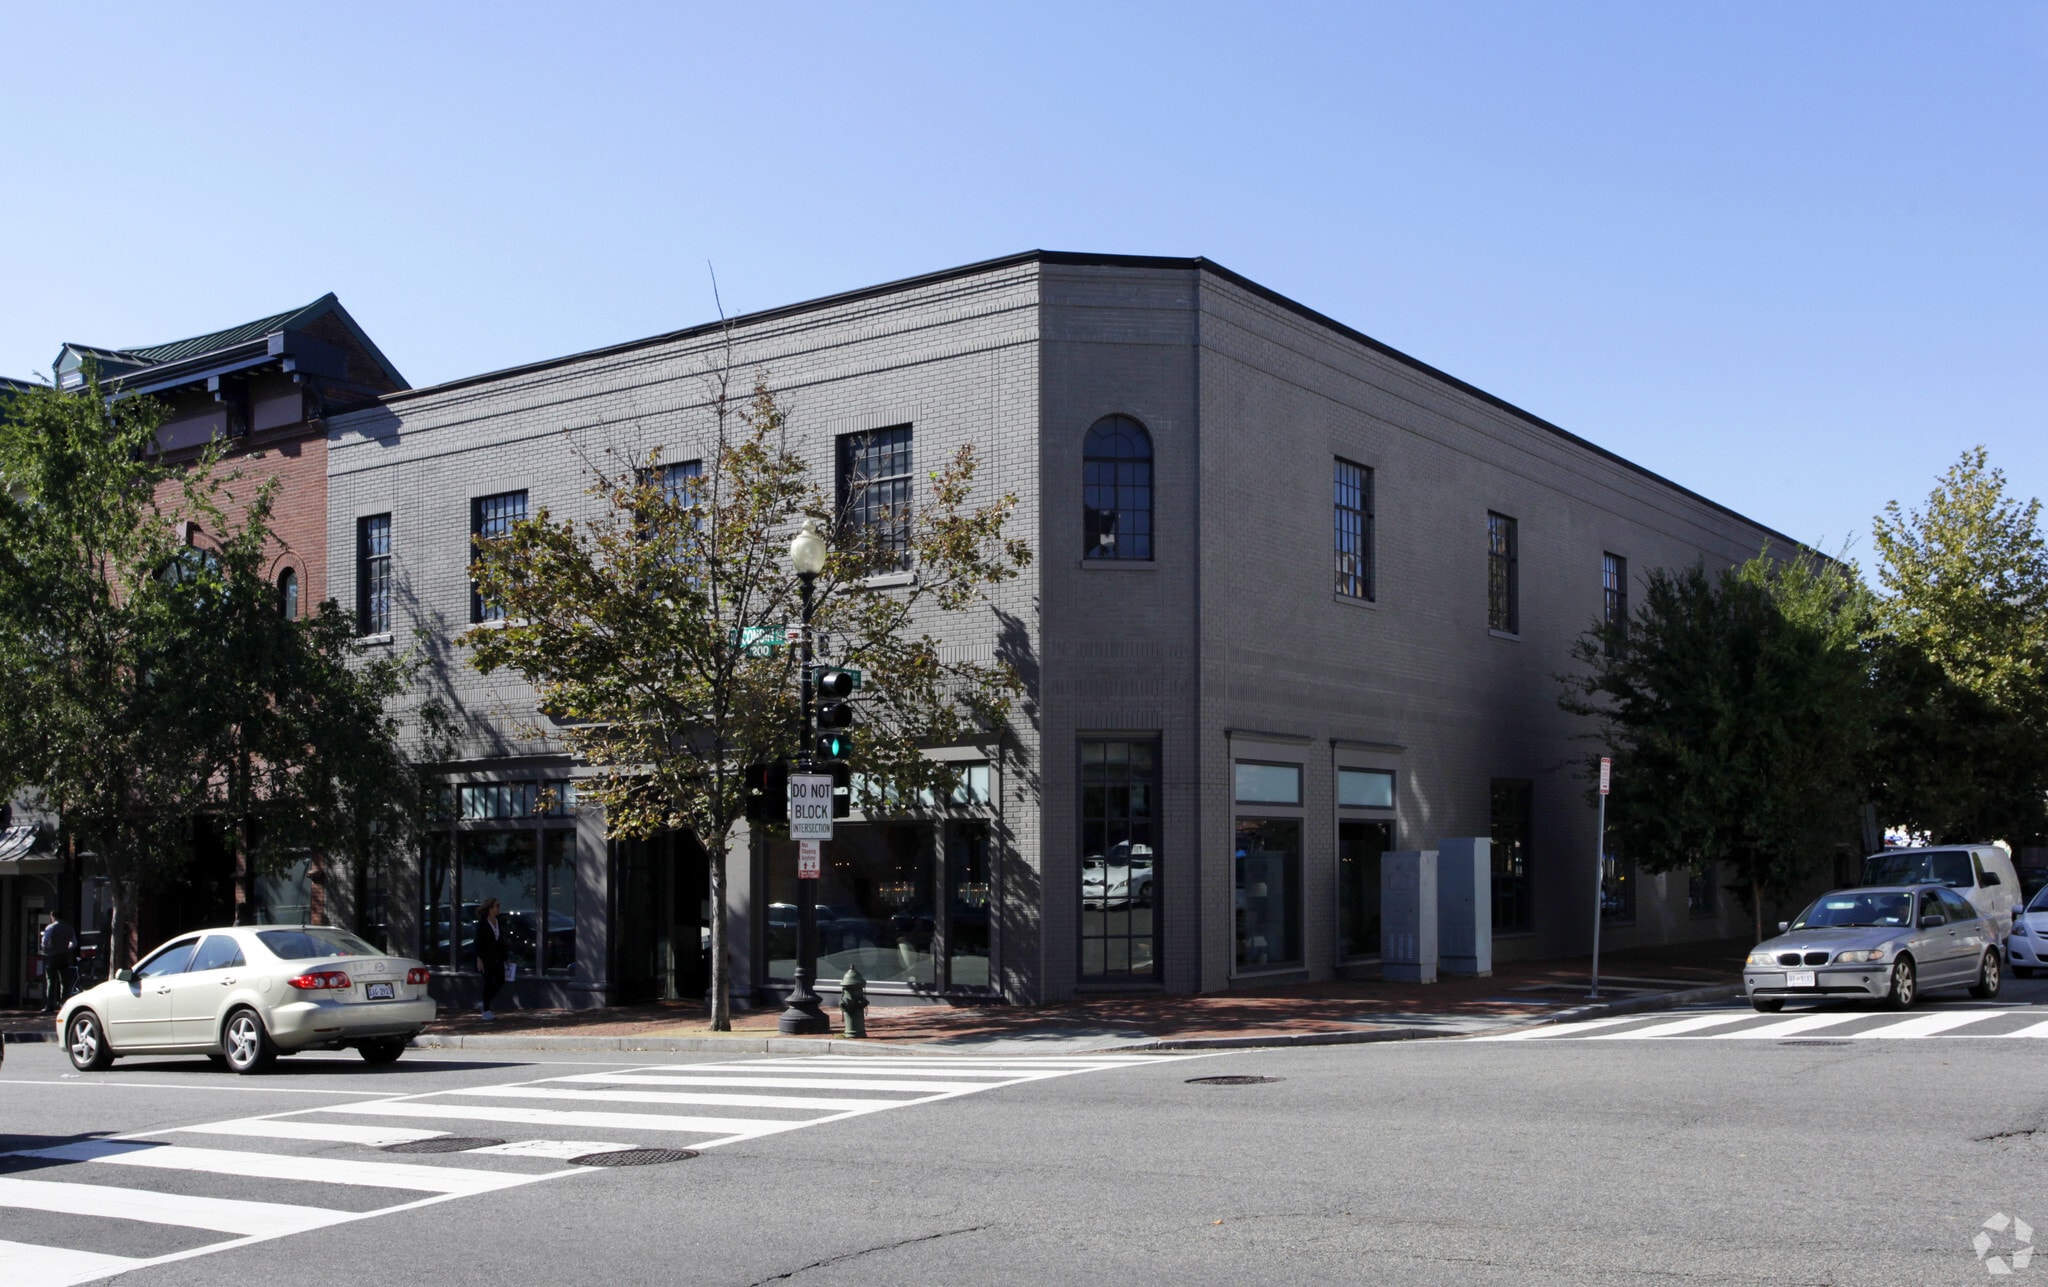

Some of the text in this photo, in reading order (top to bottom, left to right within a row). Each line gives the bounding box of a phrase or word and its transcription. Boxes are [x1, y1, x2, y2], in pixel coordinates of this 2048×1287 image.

[793, 784, 830, 798] DO NOT
[795, 805, 828, 819] BLOCK
[793, 823, 830, 834] INTERSECTION
